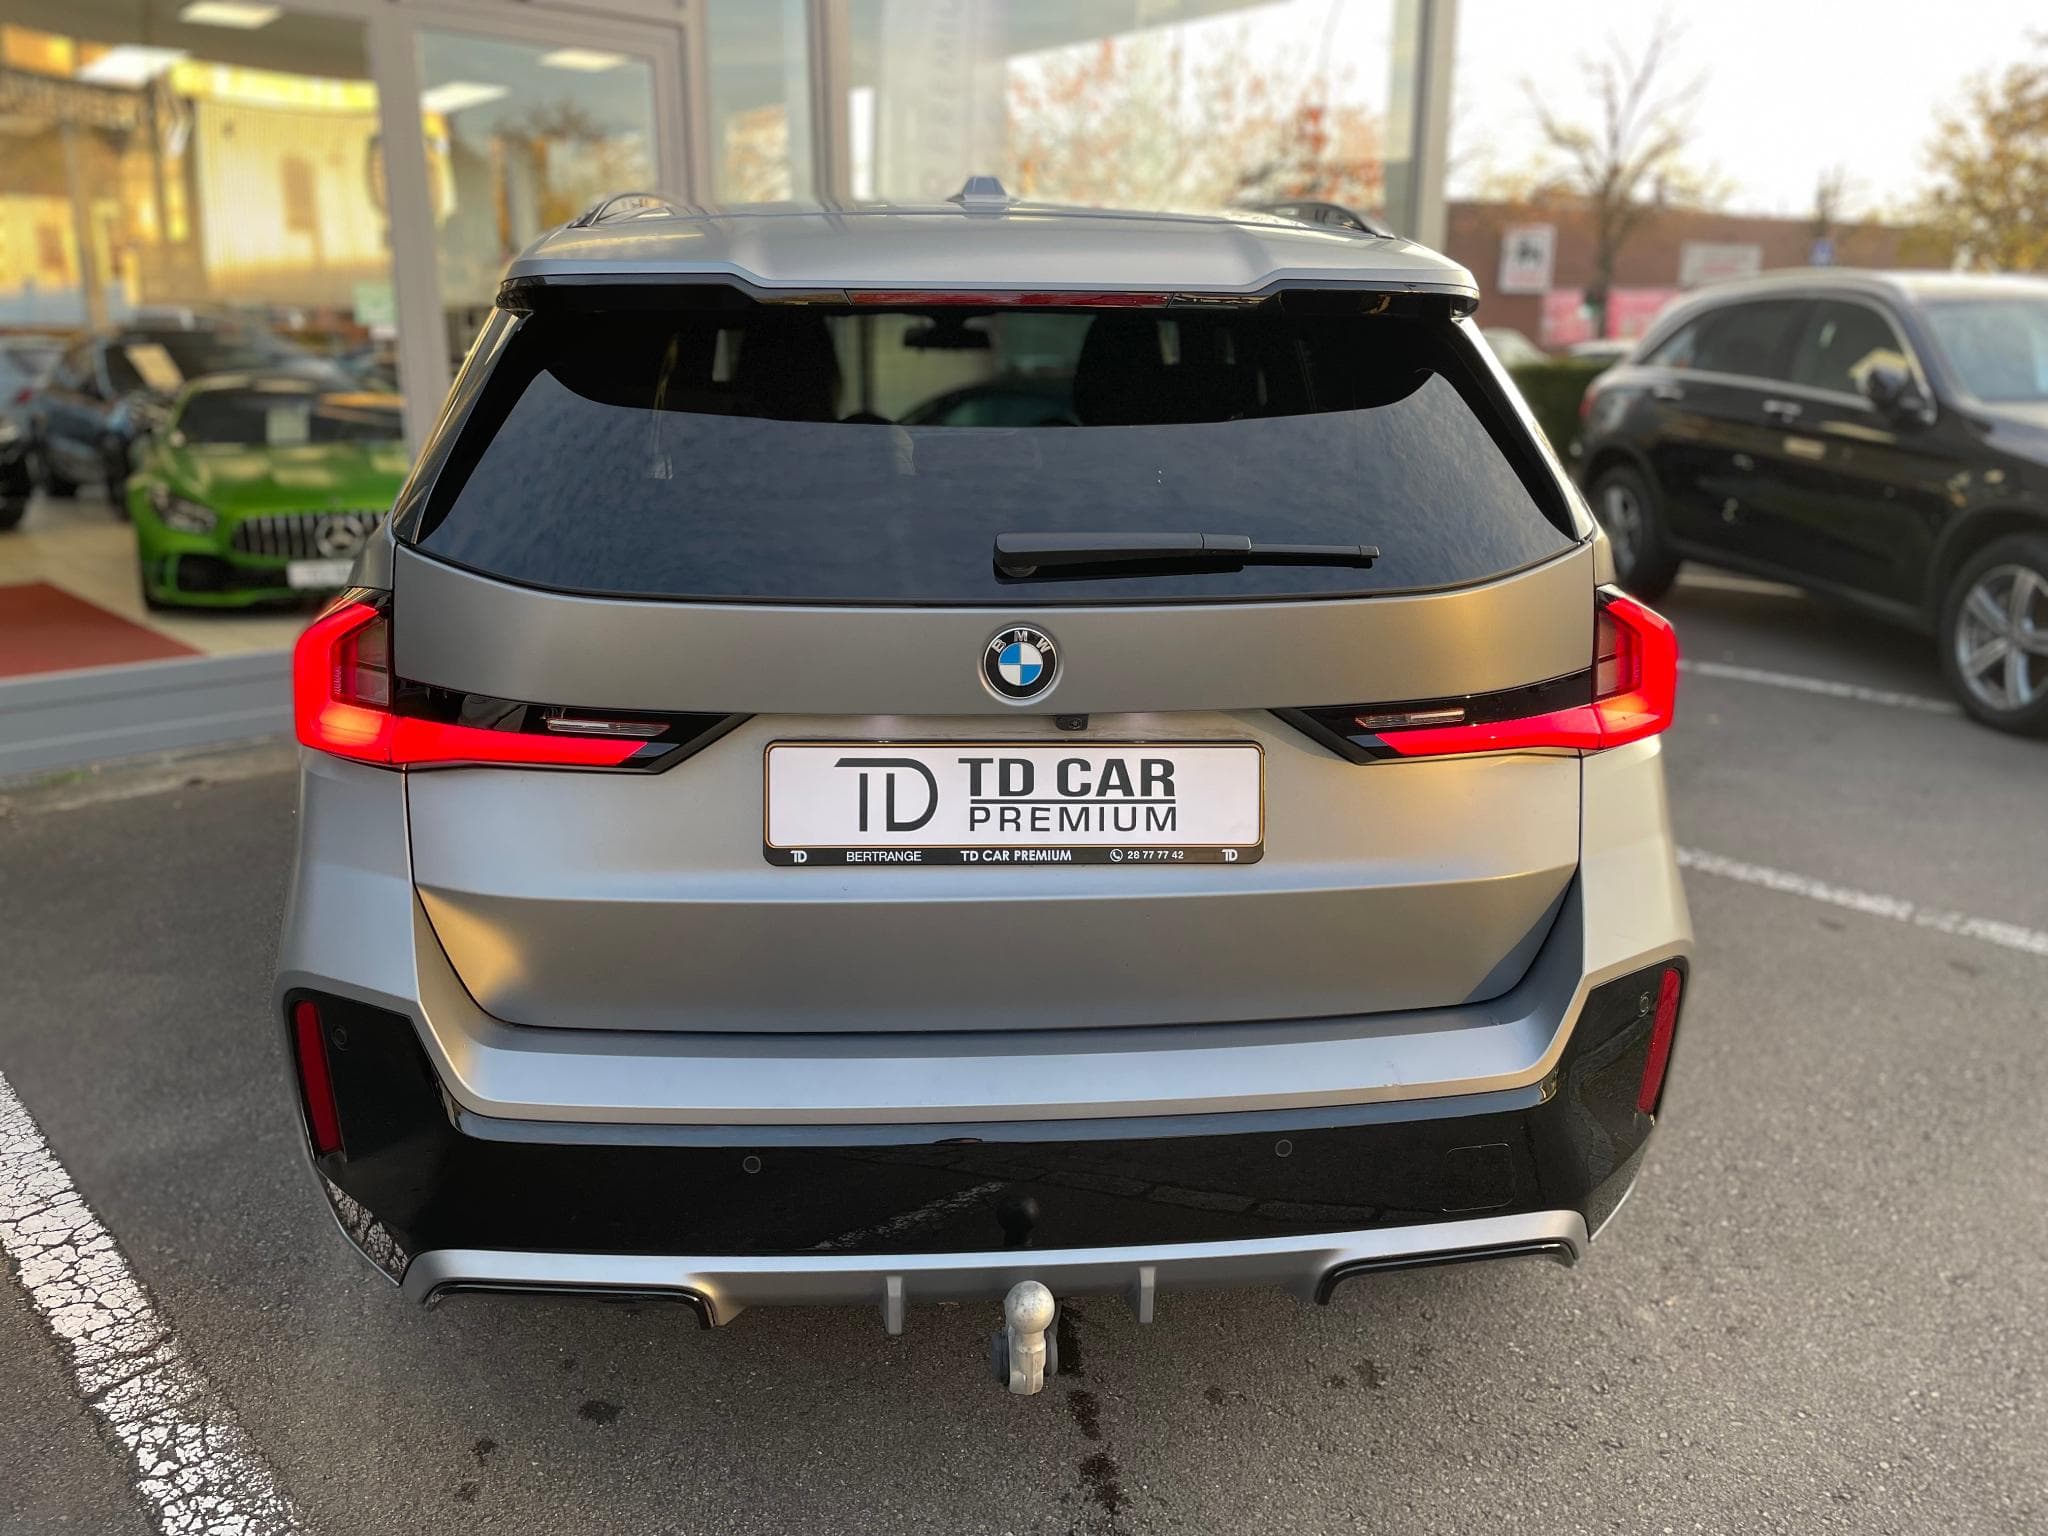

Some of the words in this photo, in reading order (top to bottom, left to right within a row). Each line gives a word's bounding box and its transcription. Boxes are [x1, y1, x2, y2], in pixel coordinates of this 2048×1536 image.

[991, 630, 1051, 653] BMW
[958, 758, 1035, 797] TD
[1056, 758, 1176, 797] CAR
[834, 757, 938, 832] TD
[969, 806, 1177, 832] PREMIUM
[790, 850, 807, 863] TD
[846, 851, 922, 862] BERTRANGE
[960, 850, 979, 861] TD
[982, 850, 1010, 861] CAR
[1014, 849, 1072, 861] PREMIUM
[1127, 850, 1140, 860] 28
[1142, 850, 1154, 860] 77
[1157, 850, 1169, 860] 77
[1171, 850, 1184, 860] 42
[1221, 849, 1238, 861] TD
